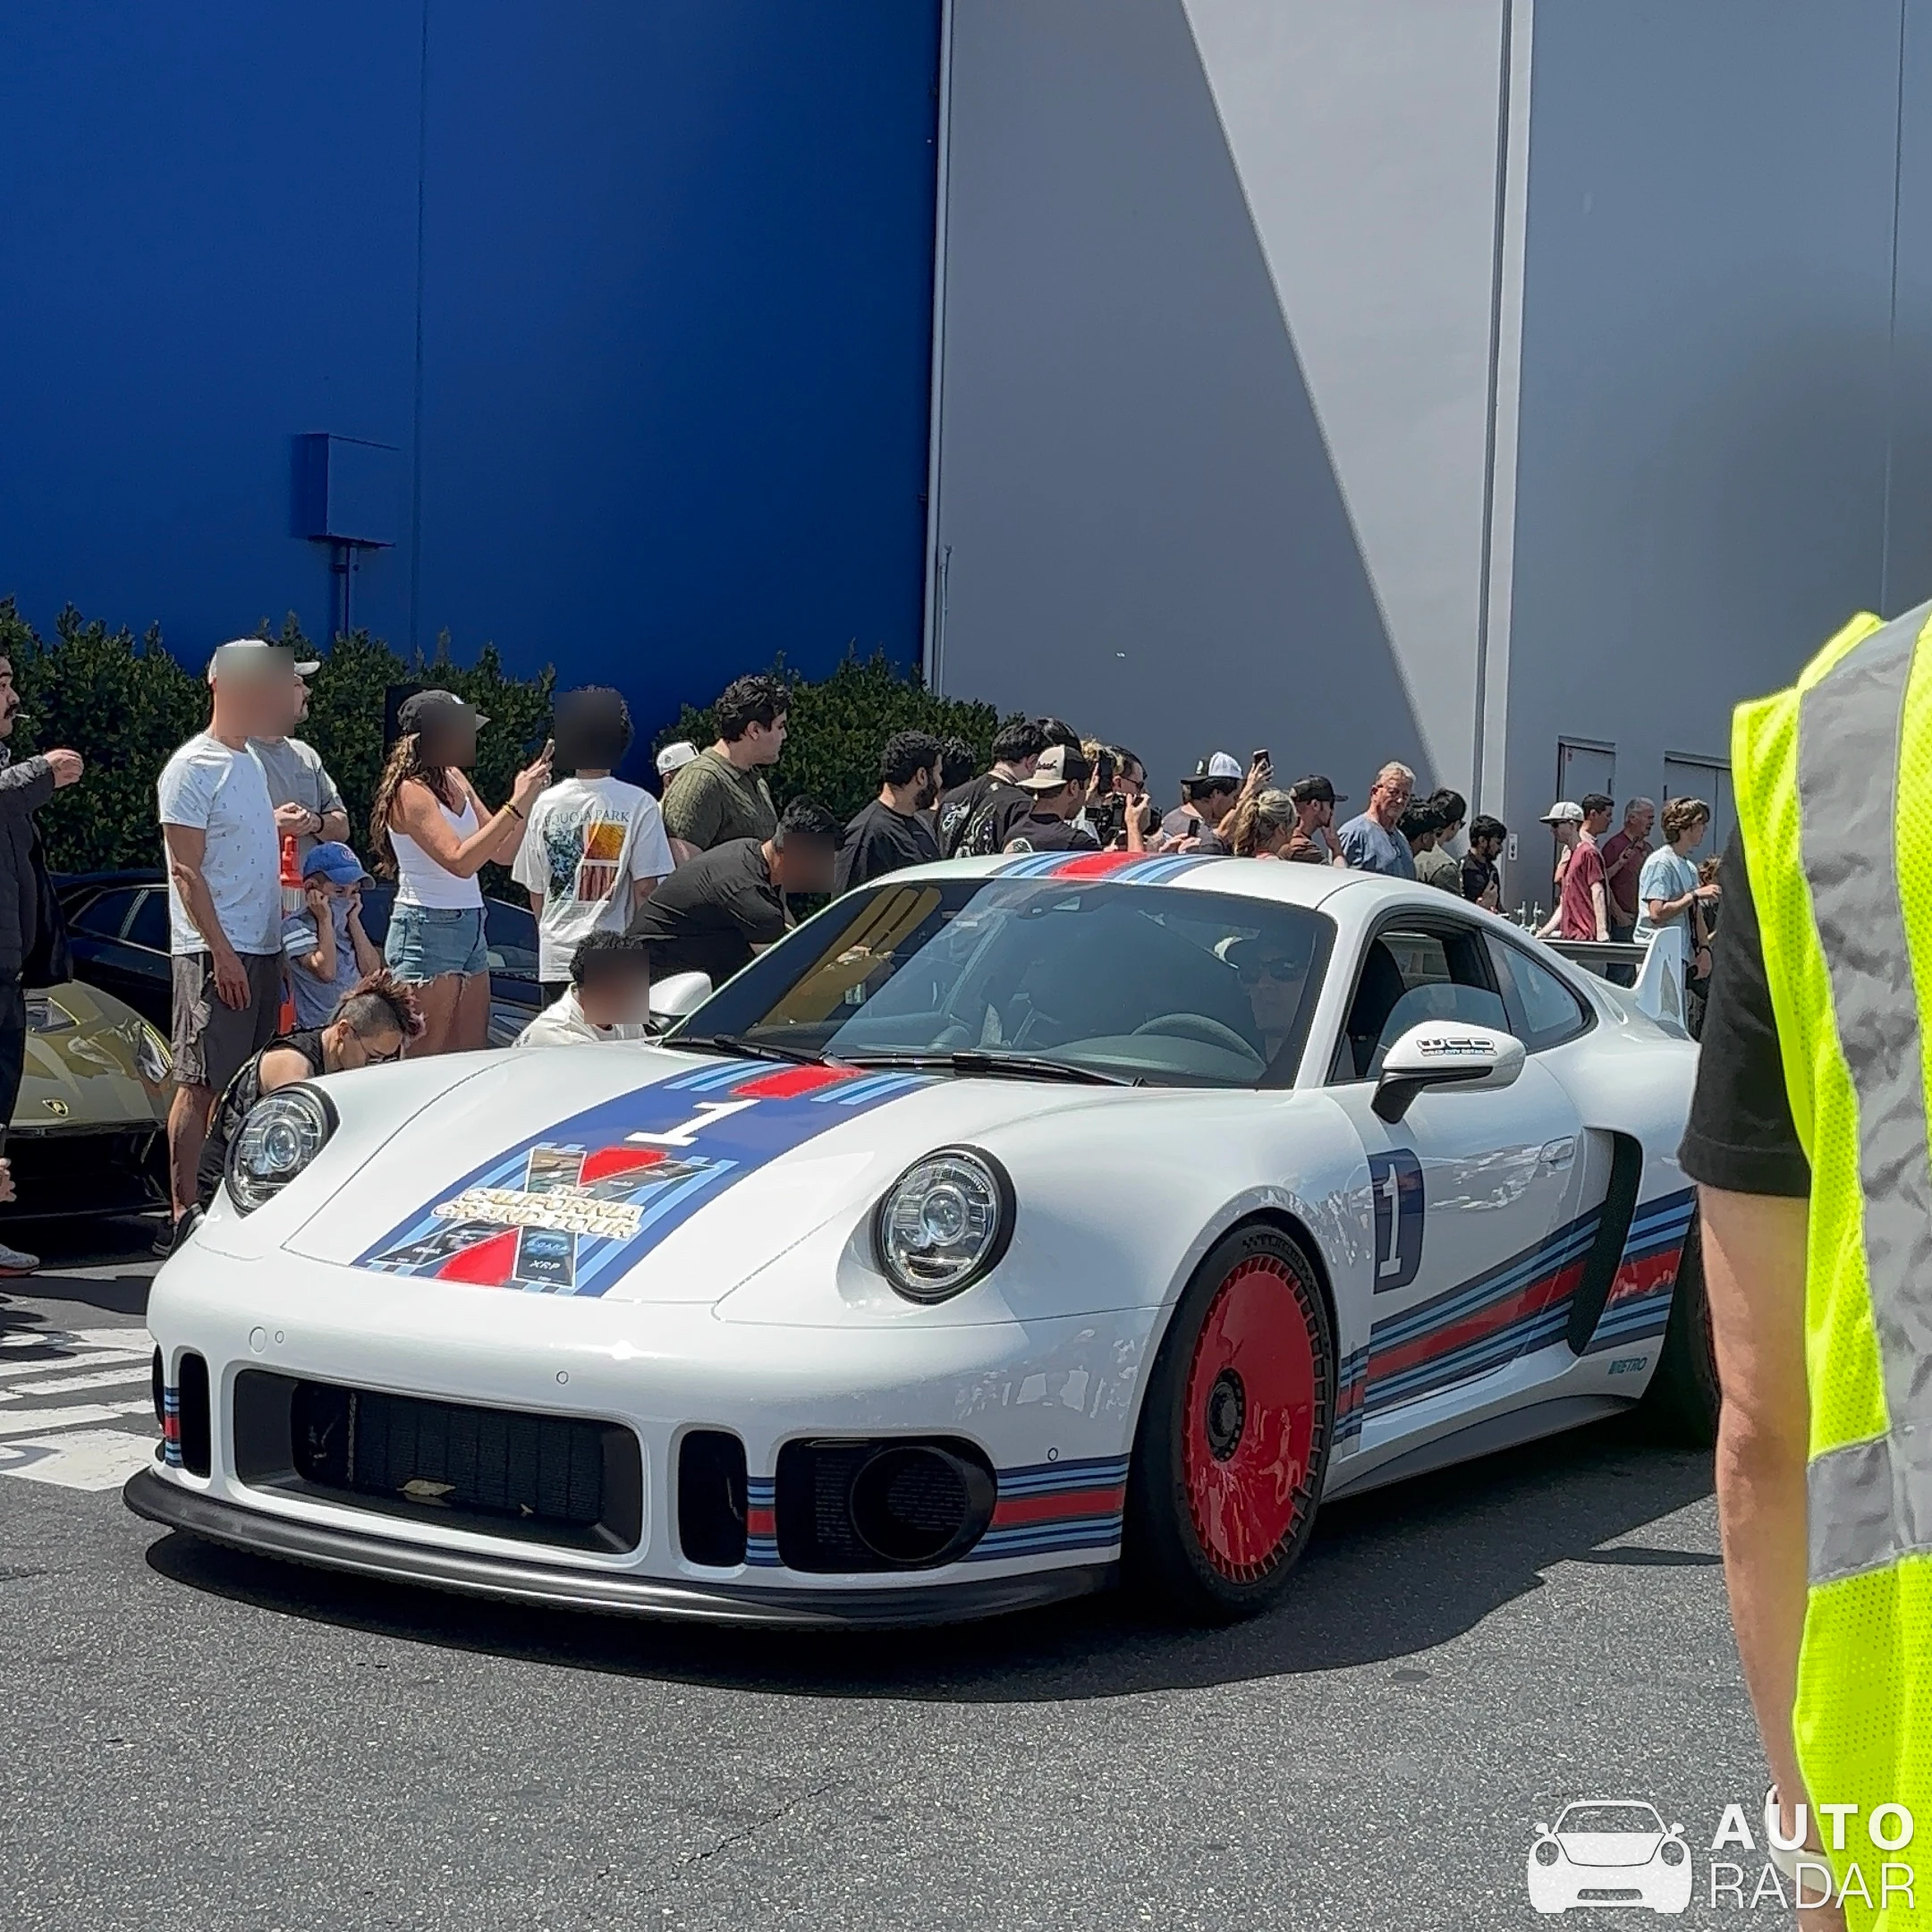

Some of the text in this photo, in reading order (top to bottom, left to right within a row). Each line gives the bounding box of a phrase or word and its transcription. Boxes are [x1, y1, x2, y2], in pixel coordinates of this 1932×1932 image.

[596, 809, 631, 823] PARK
[1416, 1037, 1495, 1049] WCD
[623, 1098, 762, 1147] 1
[460, 1189, 639, 1222] CALIFORNIA
[1378, 1163, 1402, 1277] 1
[547, 1213, 637, 1239] TOUR
